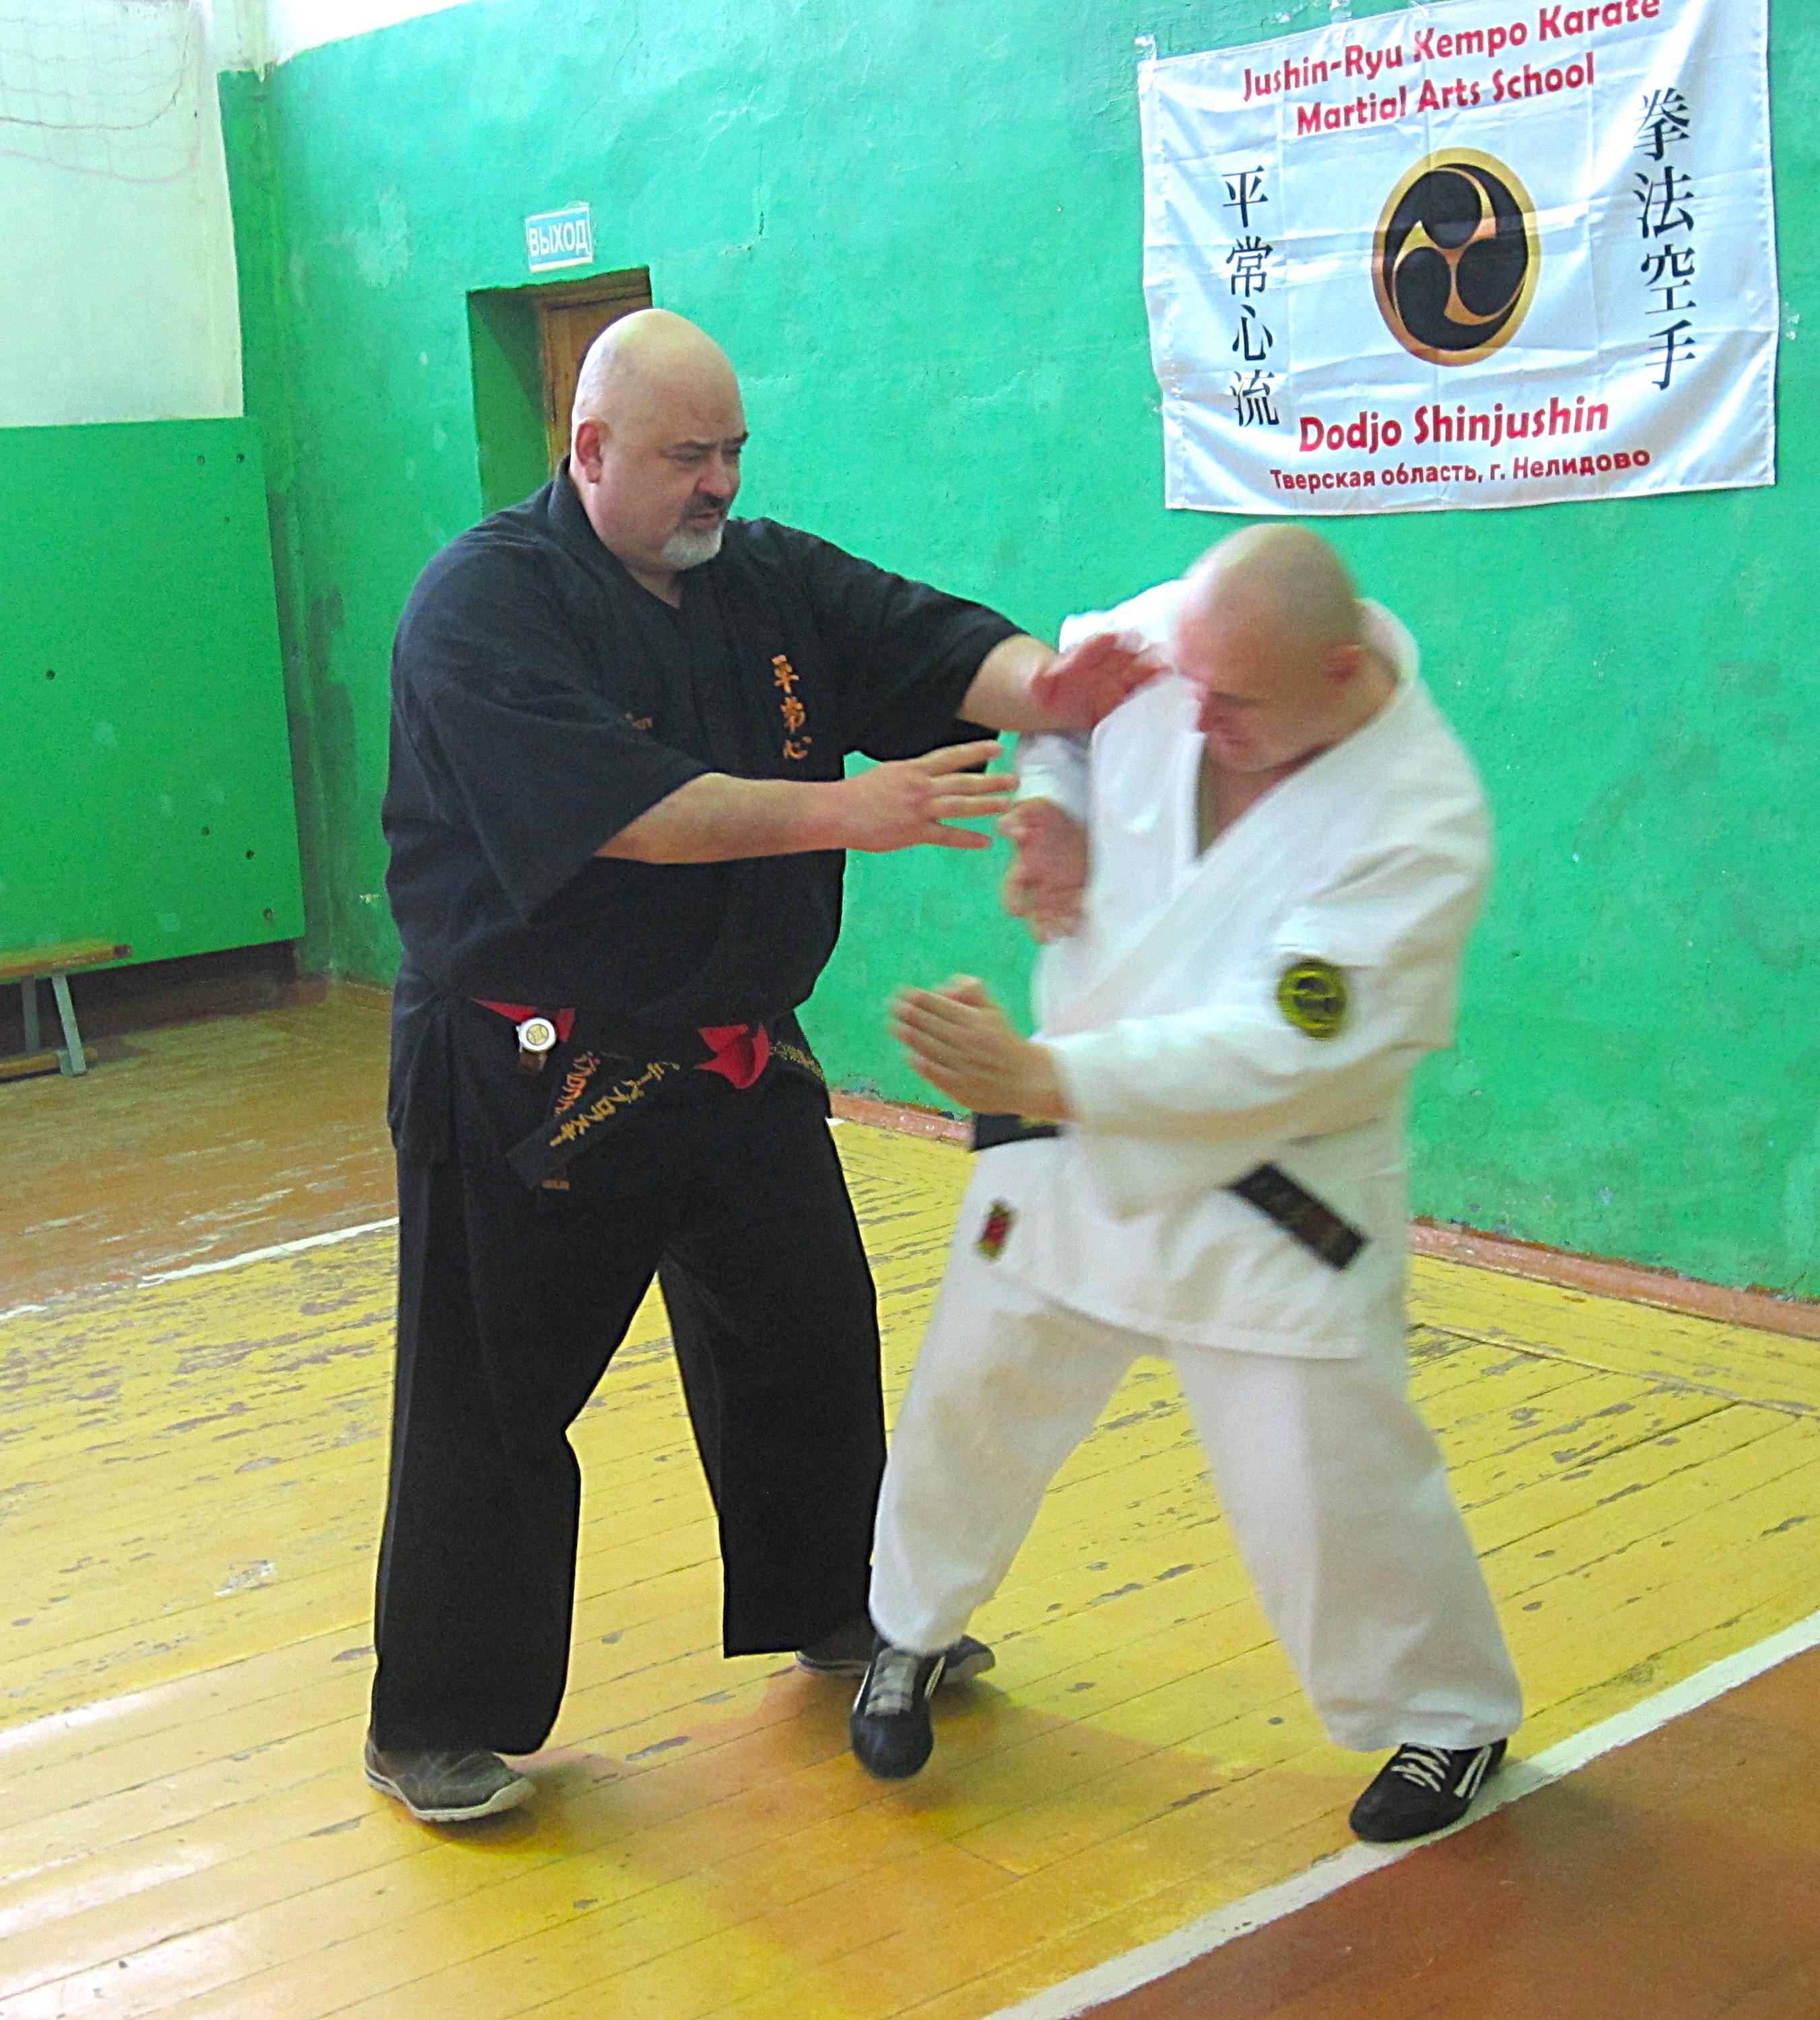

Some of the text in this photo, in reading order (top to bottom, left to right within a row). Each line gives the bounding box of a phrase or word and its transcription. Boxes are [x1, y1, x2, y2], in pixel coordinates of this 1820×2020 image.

[1244, 0, 1660, 101] Jushin-Ryu Kempo Karate
[1296, 51, 1594, 135] Martial Arts School
[528, 220, 590, 257] ВЫХОД
[1632, 85, 1697, 391] 拳法空手
[1221, 164, 1279, 428] 平常心流
[1299, 395, 1609, 454] Dodjo Shinjushin
[1269, 449, 1651, 494] Тверская область, г. Нелидово
